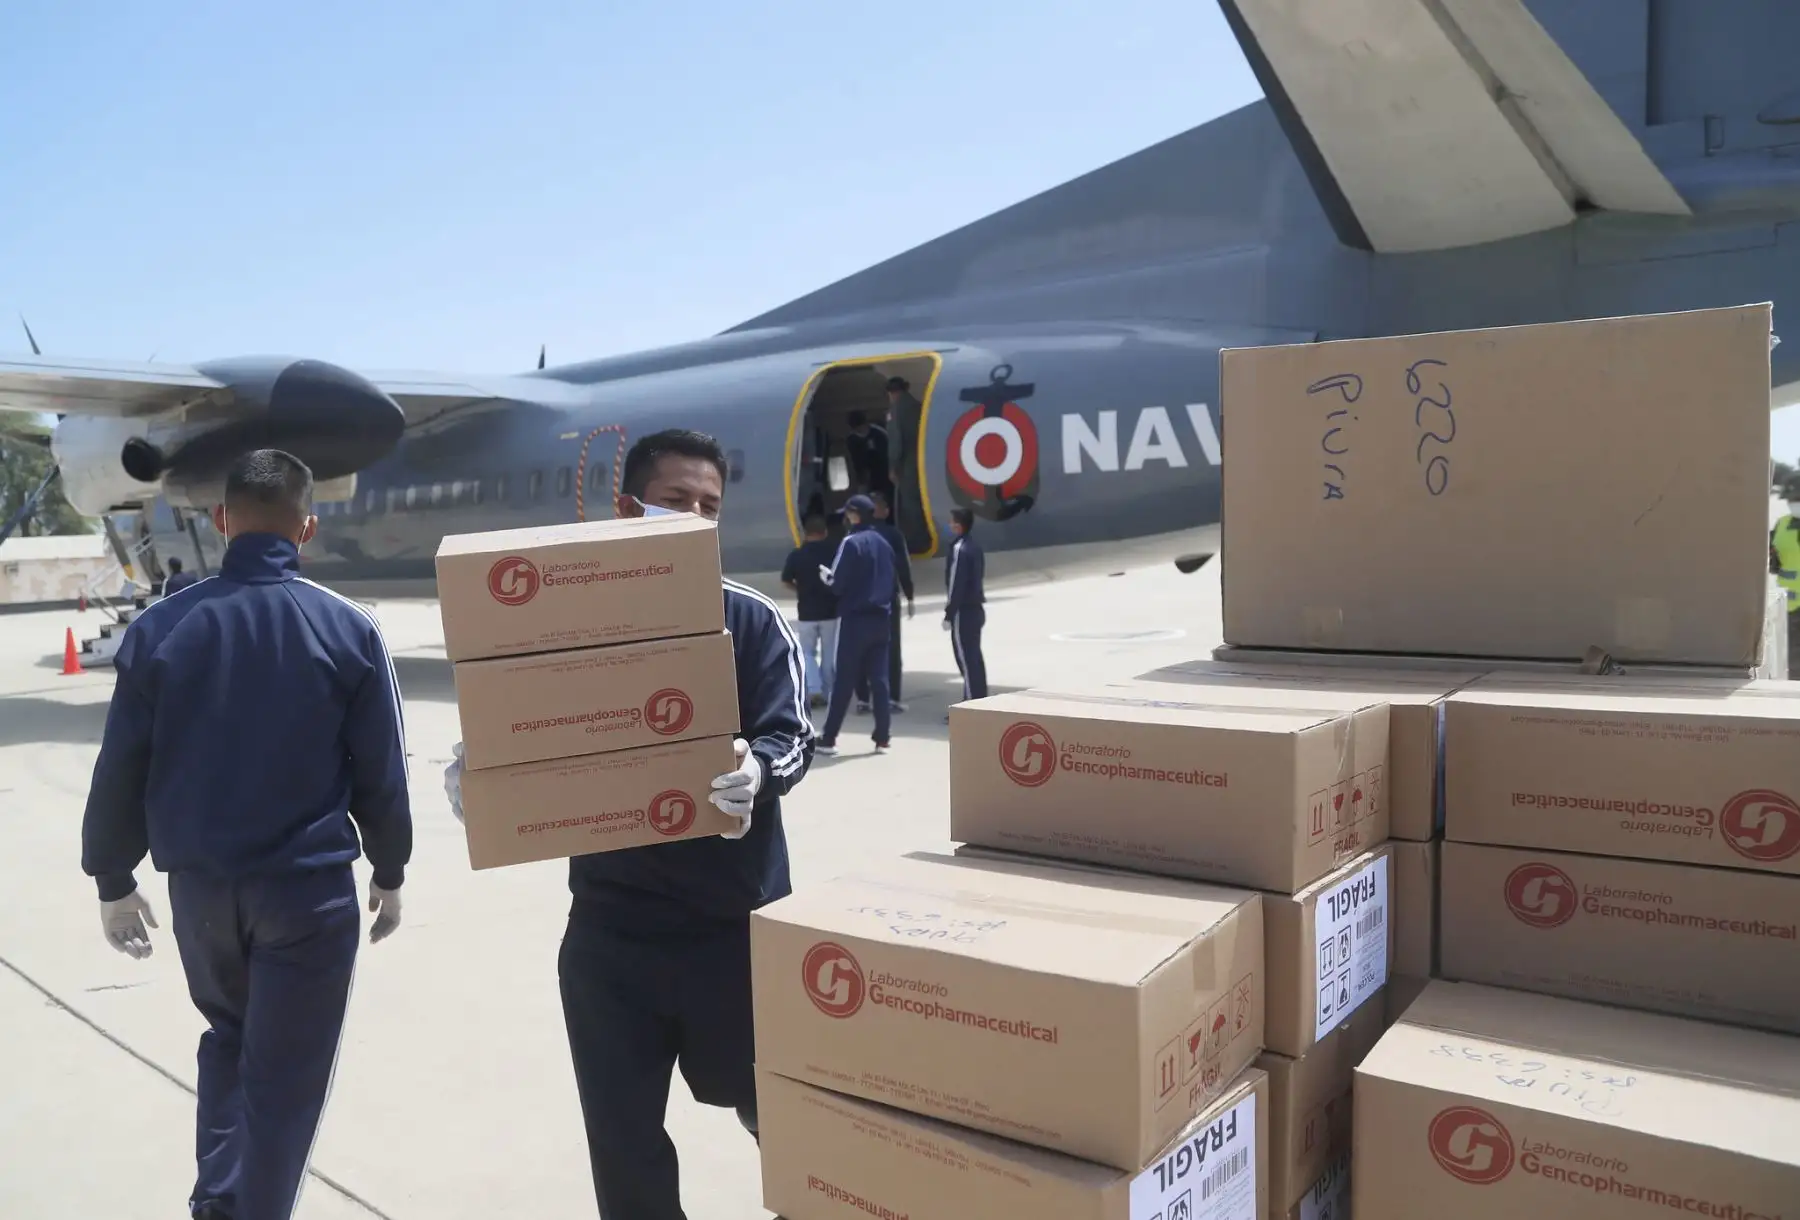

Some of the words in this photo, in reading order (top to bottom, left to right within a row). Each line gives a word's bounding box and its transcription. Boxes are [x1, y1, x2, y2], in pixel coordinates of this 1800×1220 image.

[1406, 358, 1456, 496] 6220
[542, 560, 601, 574] Laboratorio
[542, 563, 674, 587] Gencopharmaceutical
[511, 706, 642, 734] Gencopharmaceutical
[585, 720, 642, 735] Laboratorio
[1060, 740, 1131, 759] Laboratorio
[1059, 754, 1229, 788] Gencopharmaceutical
[517, 808, 645, 837] Gencopharmaceutical
[1511, 792, 1714, 827] Gencopharmaceutical
[590, 822, 646, 836] Laboratorio
[1619, 820, 1713, 839] Laboratorio
[1327, 871, 1376, 922] FRÁGIL
[1583, 883, 1673, 905] Laboratorio
[1582, 896, 1797, 940] Gencopharmaceutical
[868, 968, 948, 998] Laboratorio
[869, 985, 1058, 1045] Gencopharmaceutical
[1153, 1108, 1237, 1193] FRÁGIL
[1521, 1137, 1629, 1174] Laboratorio
